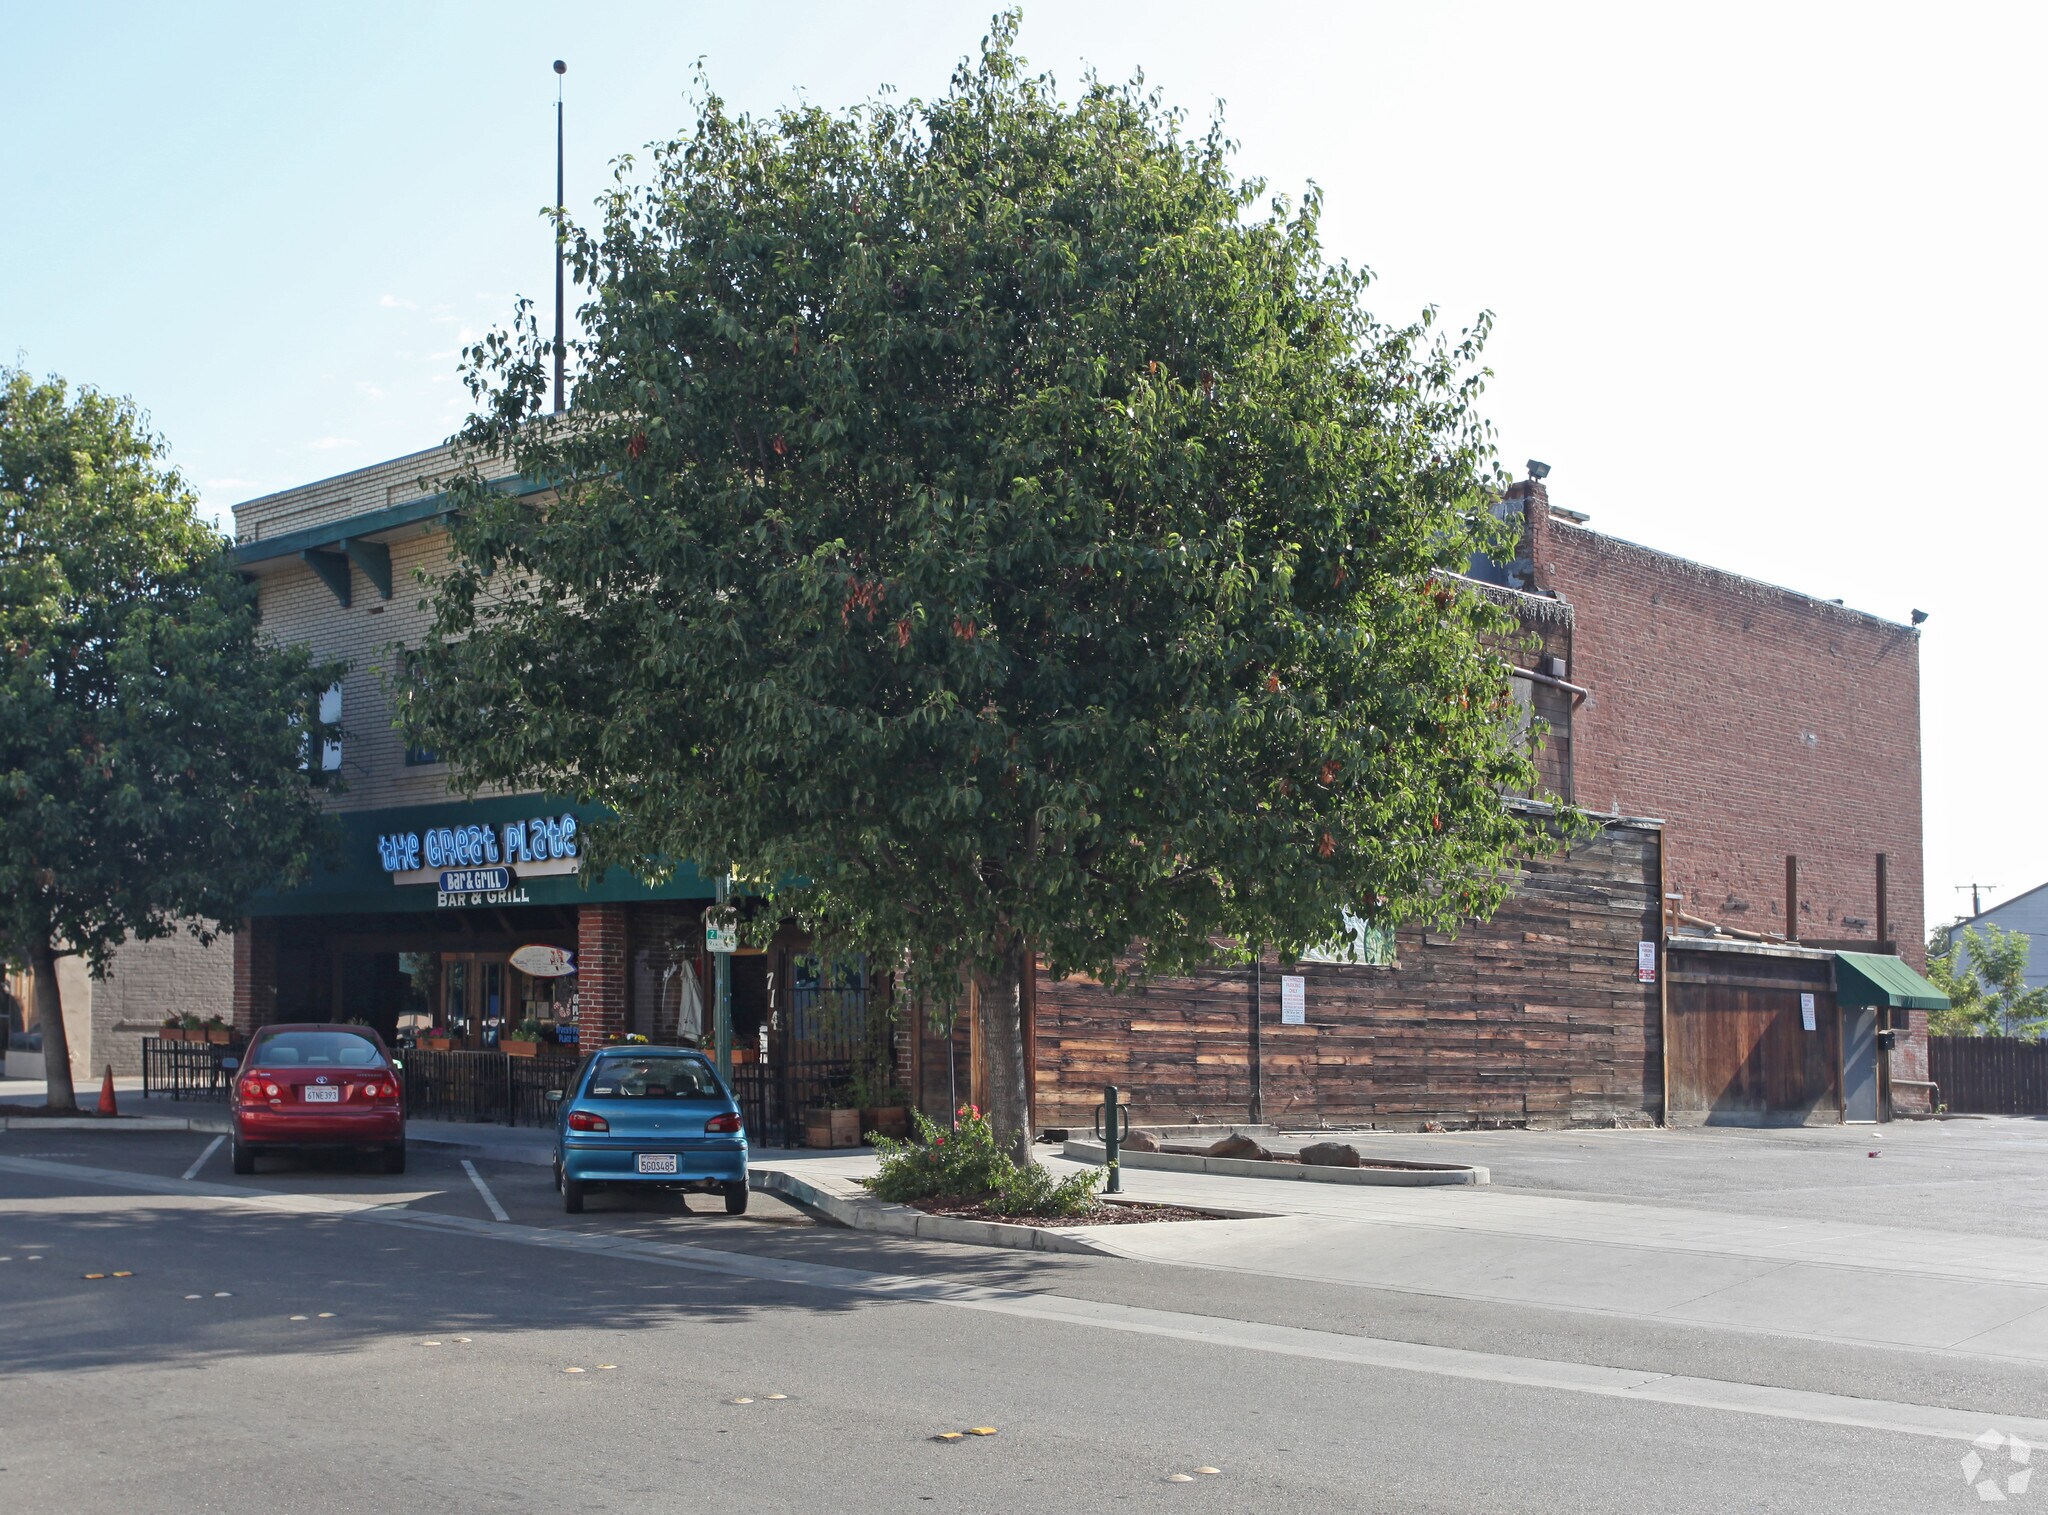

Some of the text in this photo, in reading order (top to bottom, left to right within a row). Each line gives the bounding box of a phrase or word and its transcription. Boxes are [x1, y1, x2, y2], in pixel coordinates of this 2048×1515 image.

[437, 888, 530, 907] BAR & GRILL
[307, 1091, 337, 1100] 6TNE393
